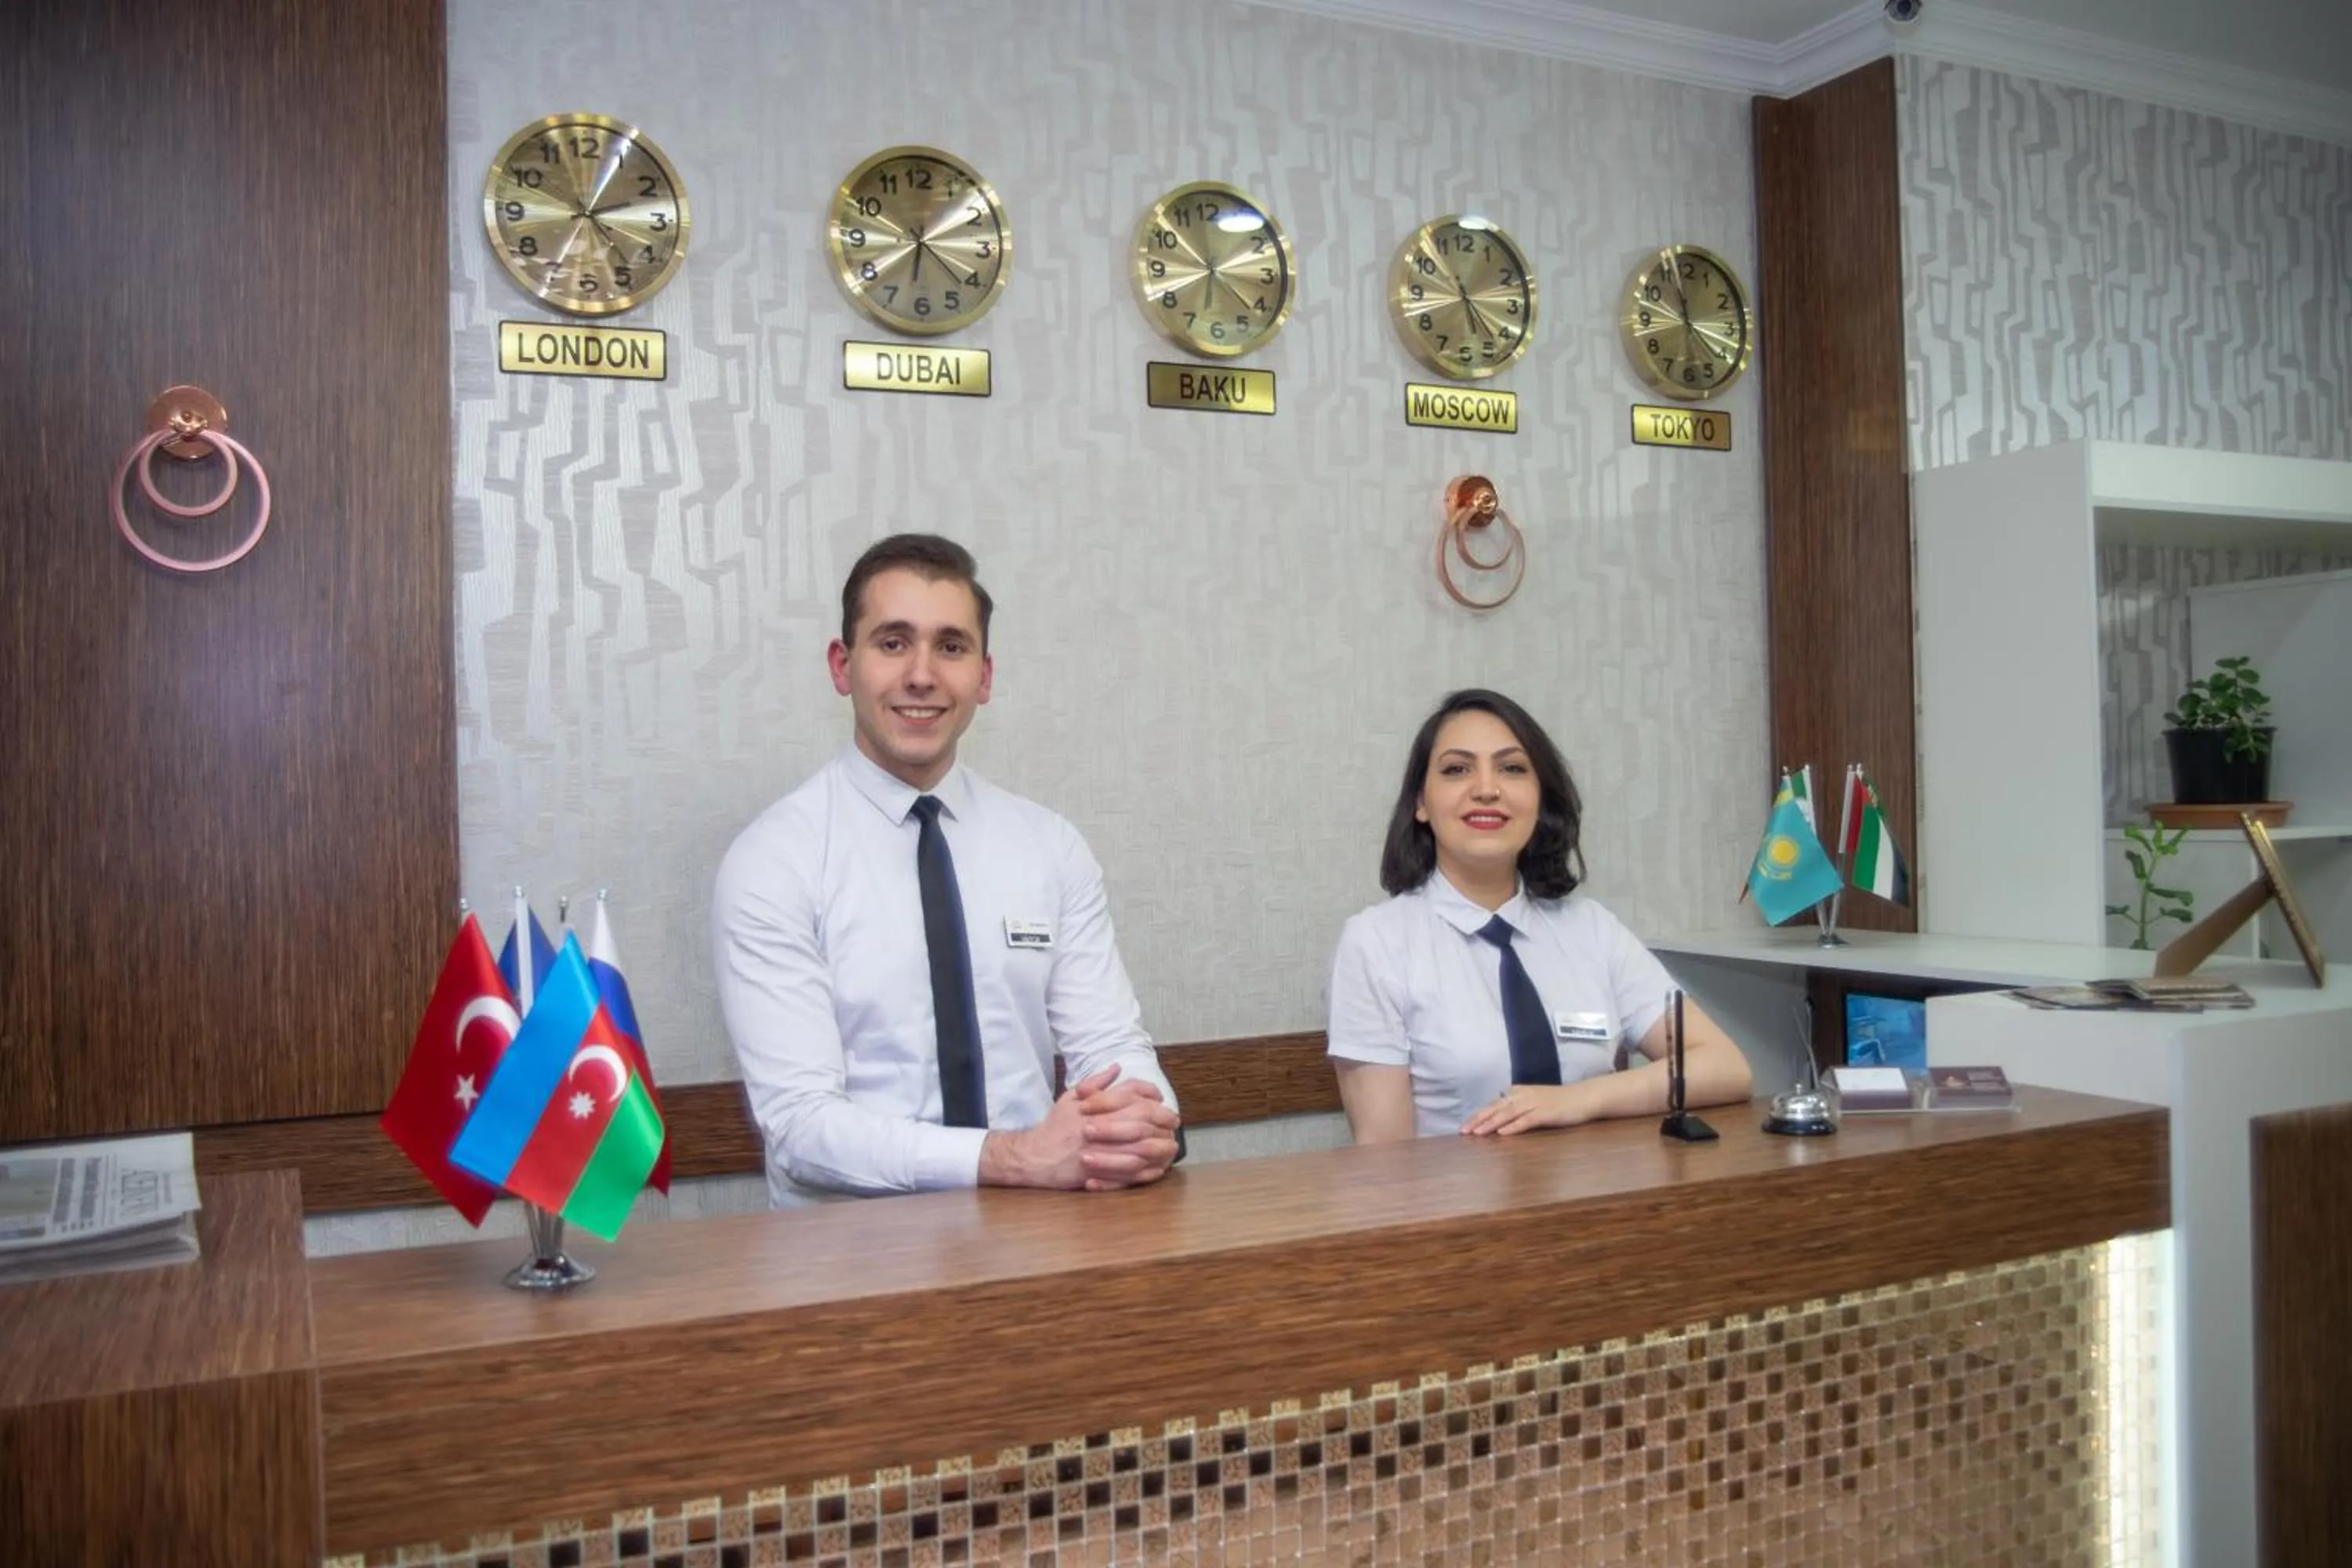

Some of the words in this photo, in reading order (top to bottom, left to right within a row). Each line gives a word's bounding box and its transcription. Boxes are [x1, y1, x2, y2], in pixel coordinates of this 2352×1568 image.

[541, 140, 560, 164] 11
[569, 138, 600, 159] 12
[514, 168, 543, 188] 10
[639, 176, 658, 197] 2
[880, 174, 898, 194] 11
[905, 169, 932, 190] 12
[505, 202, 524, 221] 9
[857, 197, 881, 217] 10
[1196, 204, 1218, 221] 12
[651, 212, 667, 231] 3
[967, 207, 982, 226] 2
[1174, 209, 1190, 227] 11
[519, 237, 538, 256] 8
[849, 229, 866, 247] 9
[1156, 231, 1177, 249] 10
[1250, 236, 1265, 254] 2
[1456, 234, 1473, 252] 12
[638, 244, 656, 263] 4
[976, 241, 990, 259] 3
[862, 261, 878, 281] 8
[1151, 260, 1165, 278] 9
[1417, 257, 1436, 274] 10
[579, 274, 599, 292] 6
[615, 266, 632, 287] 5
[964, 271, 981, 289] 4
[1261, 268, 1274, 285] 3
[1499, 269, 1512, 286] 2
[884, 285, 898, 304] 7
[945, 292, 960, 310] 5
[1162, 292, 1177, 308] 8
[1410, 285, 1424, 301] 9
[1645, 285, 1661, 301] 10
[1718, 293, 1729, 310] 2
[914, 297, 931, 315] 6
[1253, 297, 1267, 314] 4
[1507, 299, 1518, 314] 3
[1183, 312, 1196, 329] 7
[1236, 316, 1249, 332] 5
[1419, 314, 1432, 331] 8
[1639, 311, 1650, 327] 9
[1210, 321, 1225, 339] 6
[1499, 327, 1511, 340] 4
[1726, 322, 1734, 336] 3
[518, 332, 649, 369] LONDON
[1436, 336, 1448, 351] 7
[1648, 339, 1659, 354] 8
[877, 352, 960, 385] DUBAI
[1663, 358, 1673, 372] 7
[1703, 364, 1713, 378] 5
[1683, 368, 1695, 383] 6
[1180, 373, 1246, 404] BAKU
[1414, 391, 1509, 424] MOSCOW
[1650, 414, 1715, 441] TOKYO
